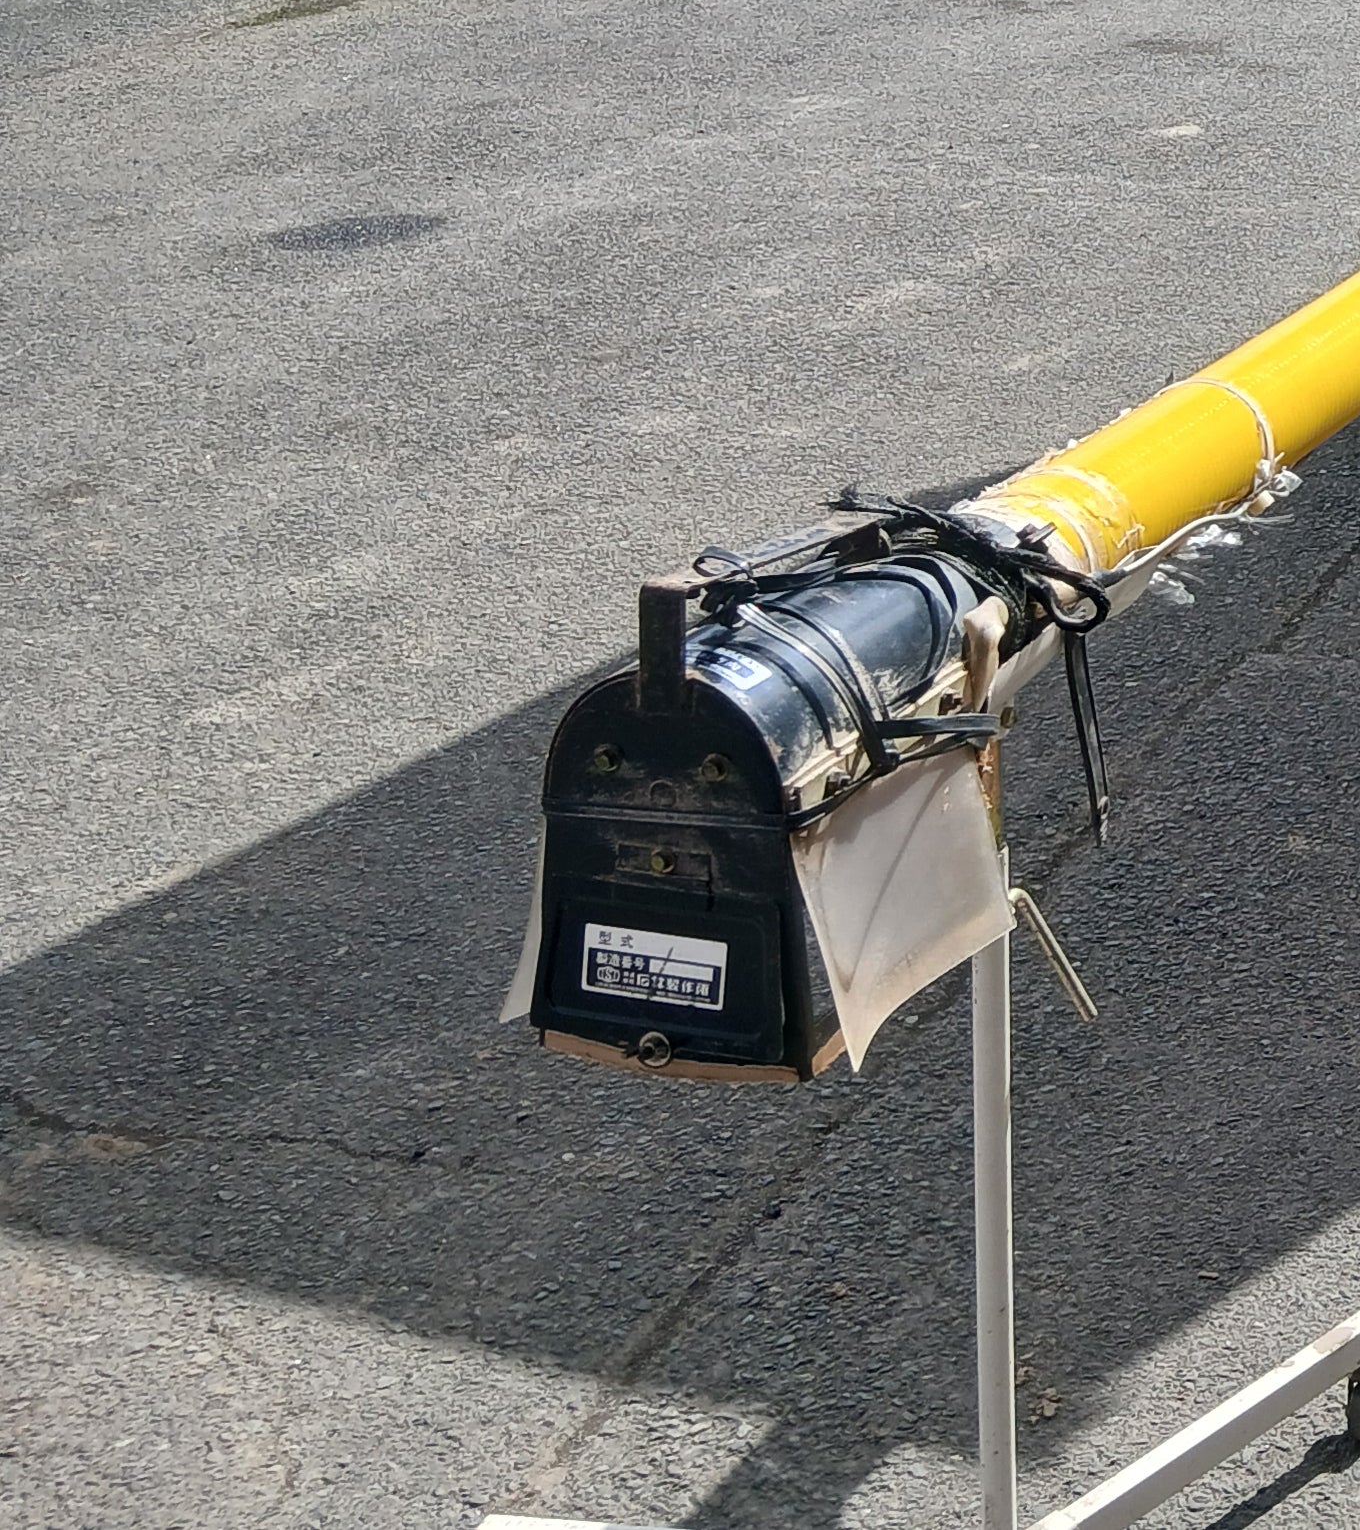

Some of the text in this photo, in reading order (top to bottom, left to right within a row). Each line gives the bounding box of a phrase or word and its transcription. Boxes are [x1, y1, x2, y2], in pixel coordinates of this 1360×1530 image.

[598, 931, 634, 949] 型式
[596, 951, 645, 971] 製造番号
